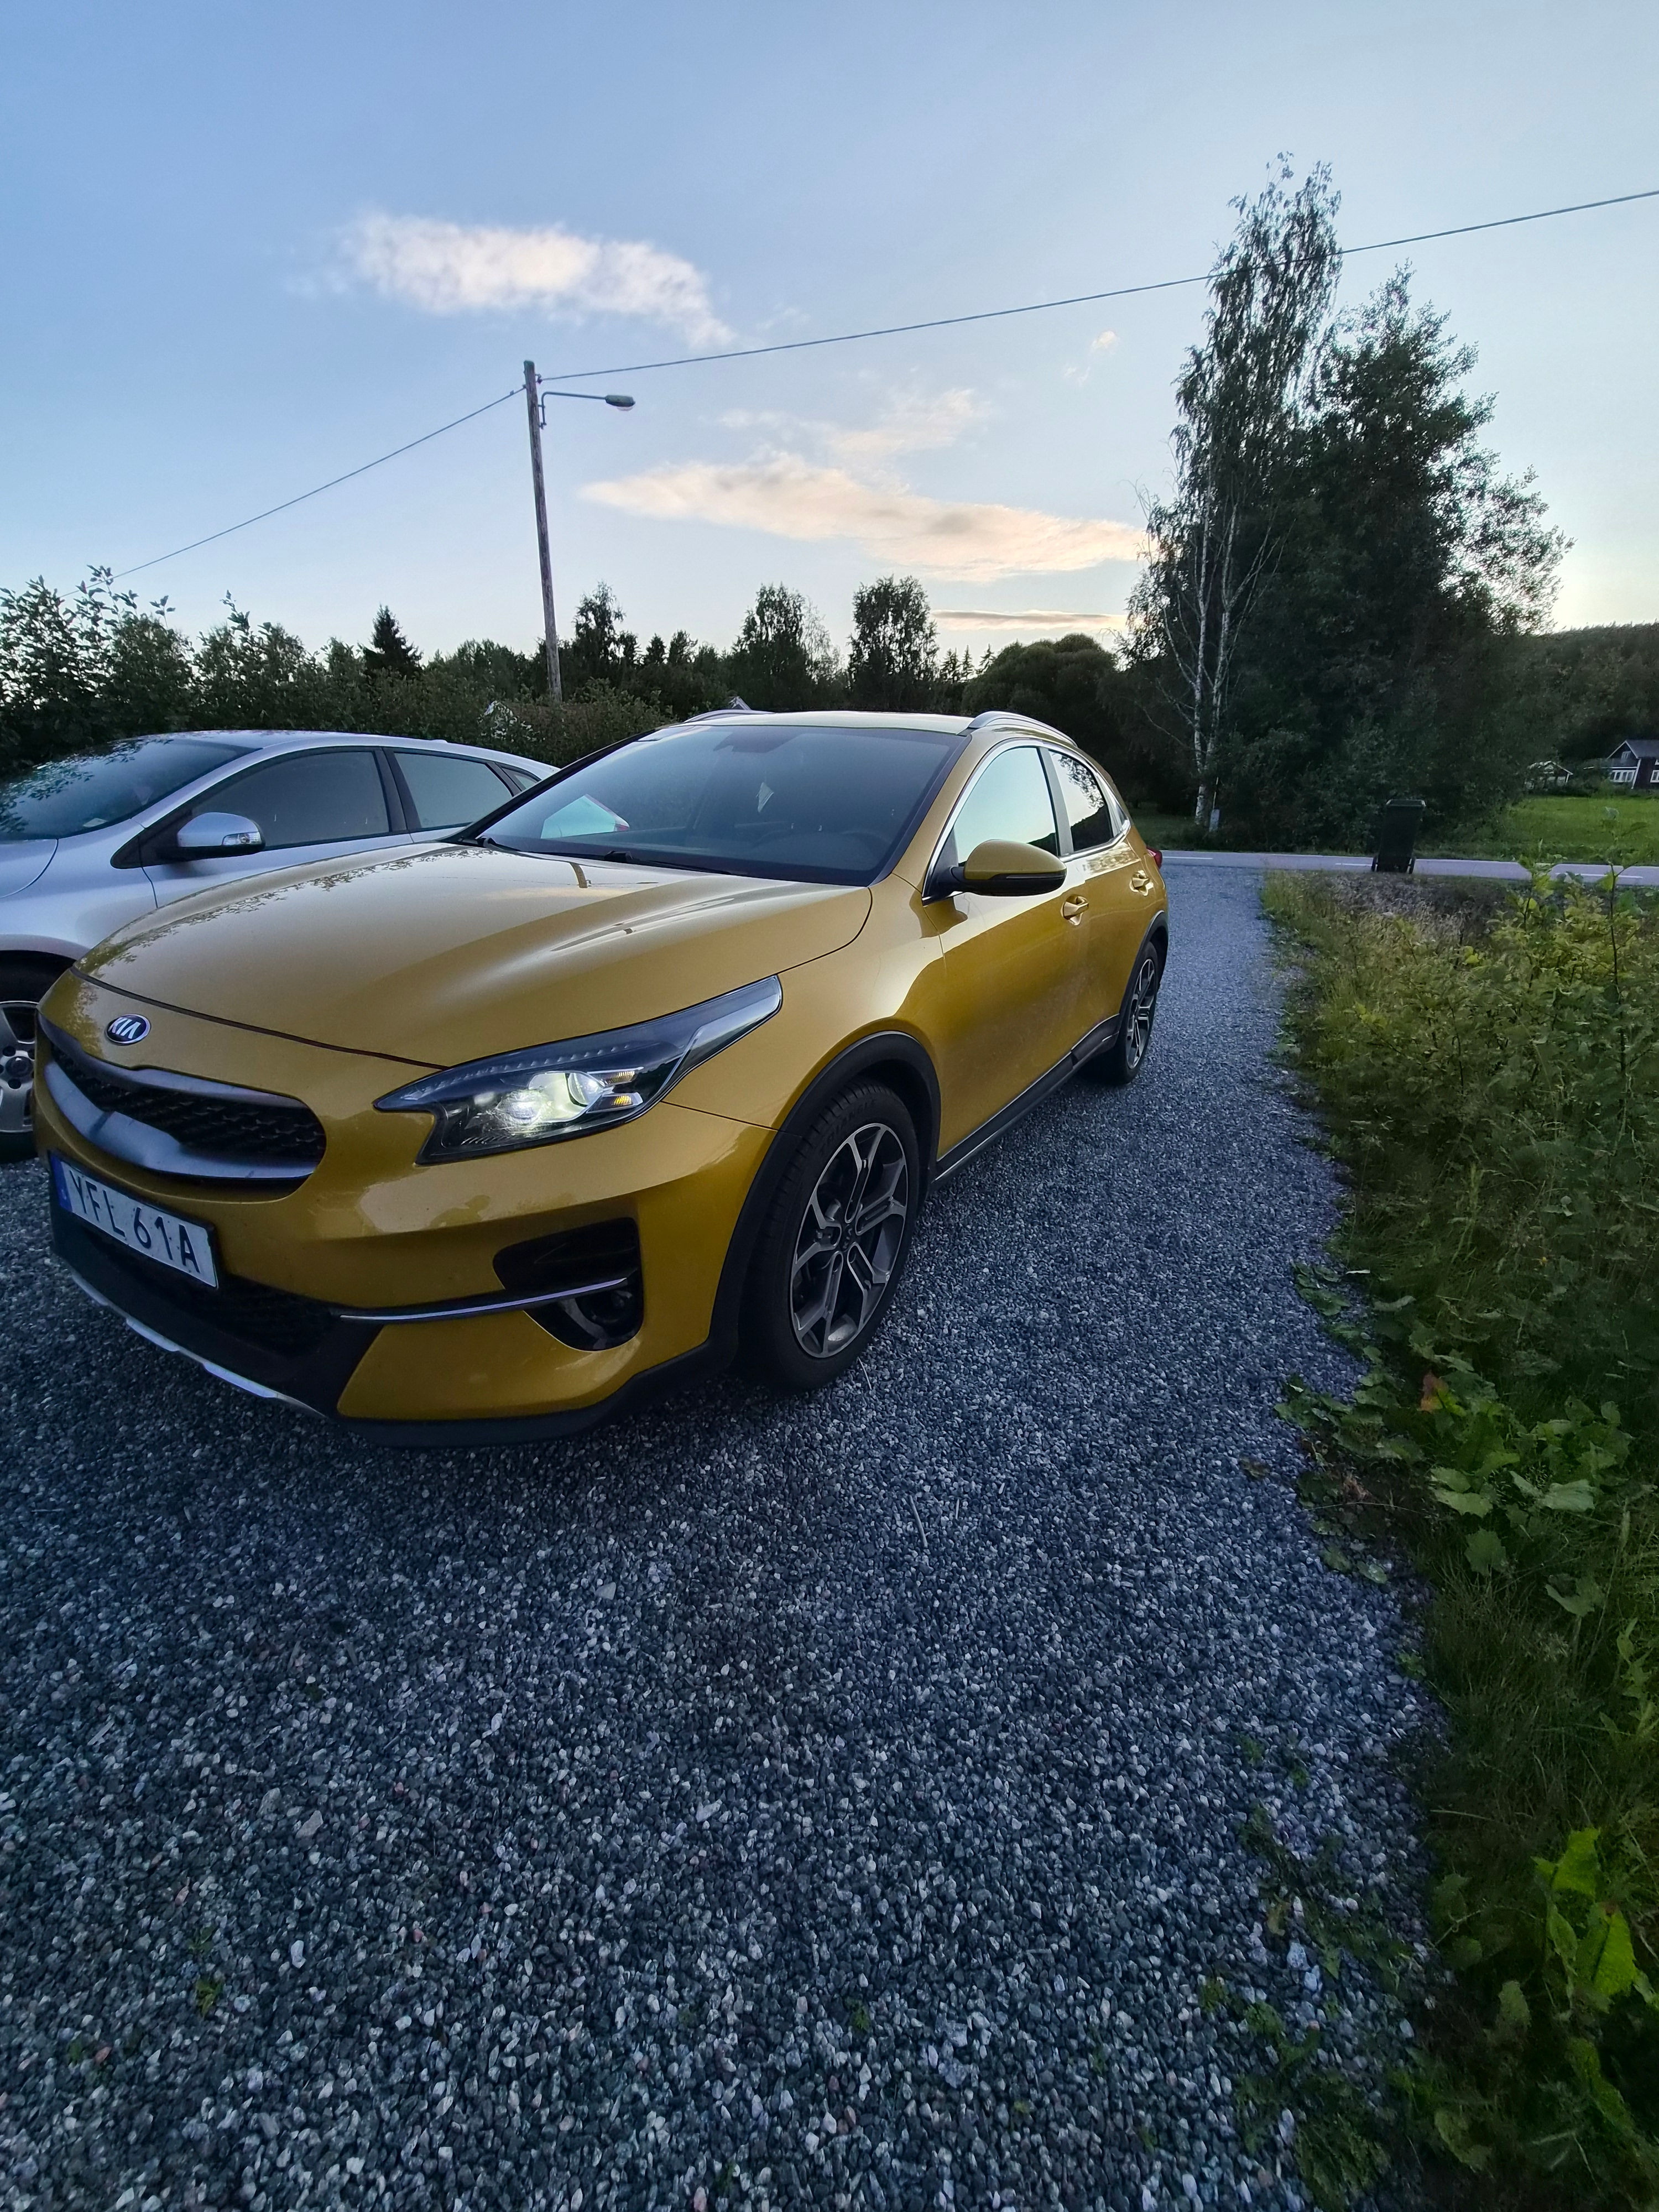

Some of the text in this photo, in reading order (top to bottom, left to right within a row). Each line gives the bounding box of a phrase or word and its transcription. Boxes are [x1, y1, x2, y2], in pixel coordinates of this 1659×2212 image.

[108, 1018, 142, 1039] KIA
[70, 1169, 201, 1274] YFL 61A
